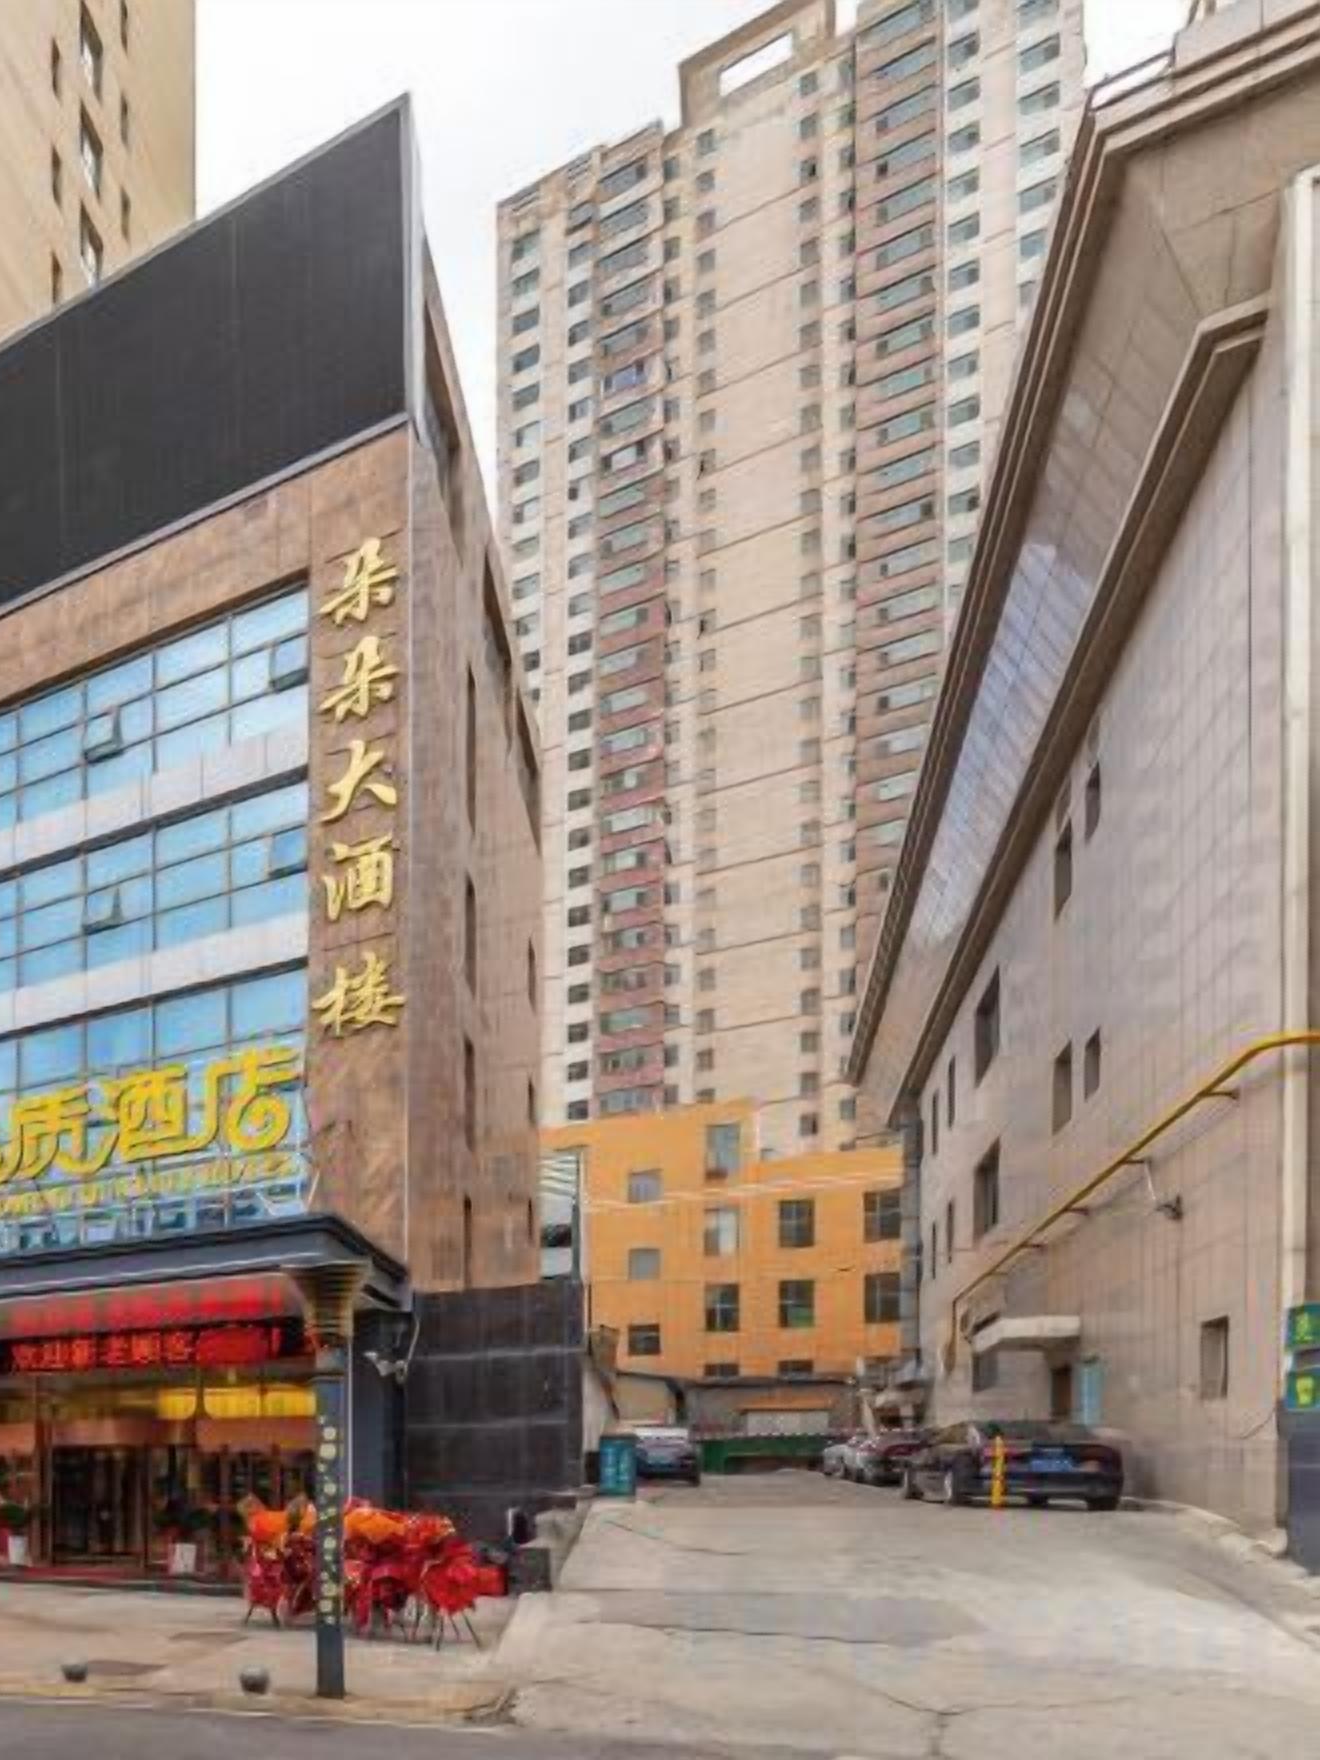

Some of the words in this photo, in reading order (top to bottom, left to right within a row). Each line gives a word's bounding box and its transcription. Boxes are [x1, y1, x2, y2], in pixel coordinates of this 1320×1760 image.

[312, 536, 406, 1037] 朵朵大酒楼
